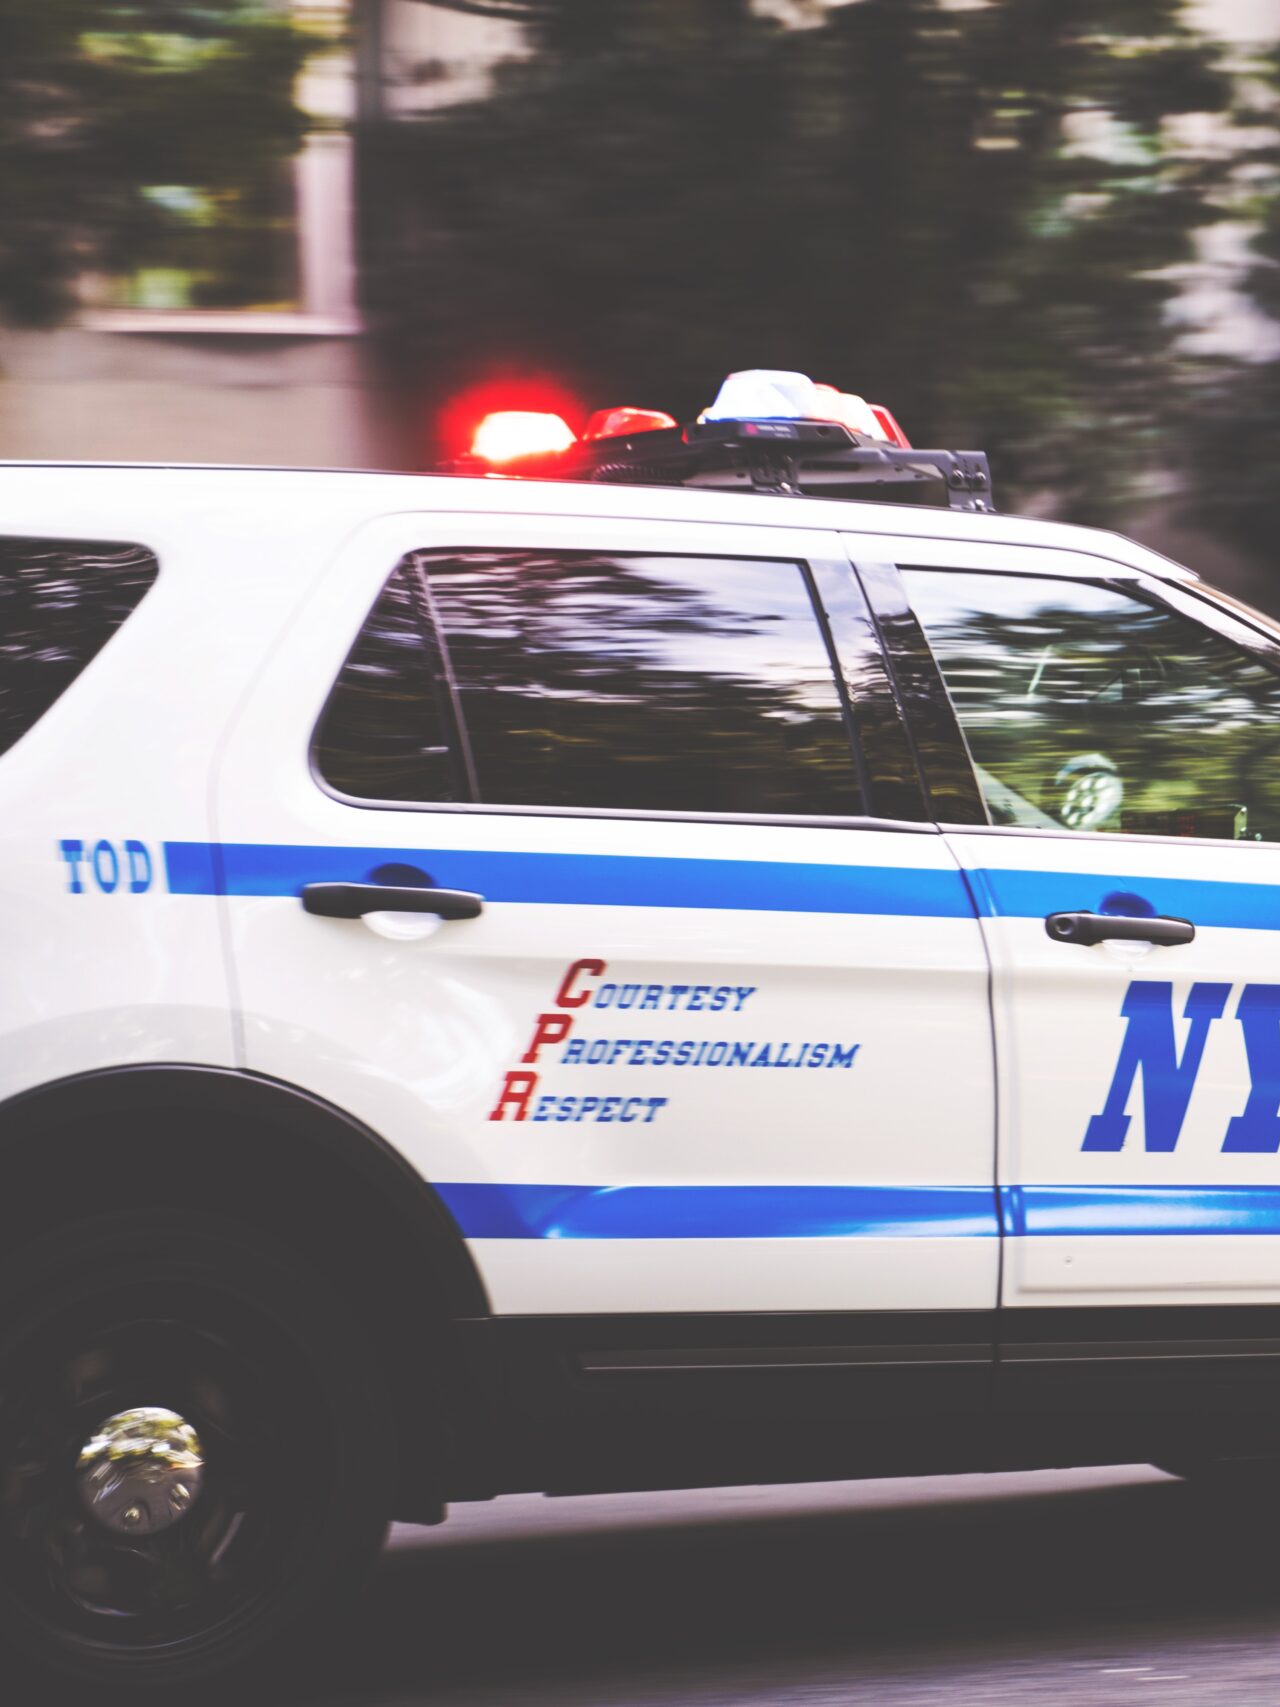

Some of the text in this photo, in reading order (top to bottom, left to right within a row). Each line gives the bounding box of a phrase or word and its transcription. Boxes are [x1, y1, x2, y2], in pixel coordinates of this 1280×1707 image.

[57, 838, 153, 895] TOD
[555, 958, 755, 1012] COURTESY
[520, 1013, 861, 1069] PROFESSIONALISM
[488, 1070, 668, 1122] RESPECT
